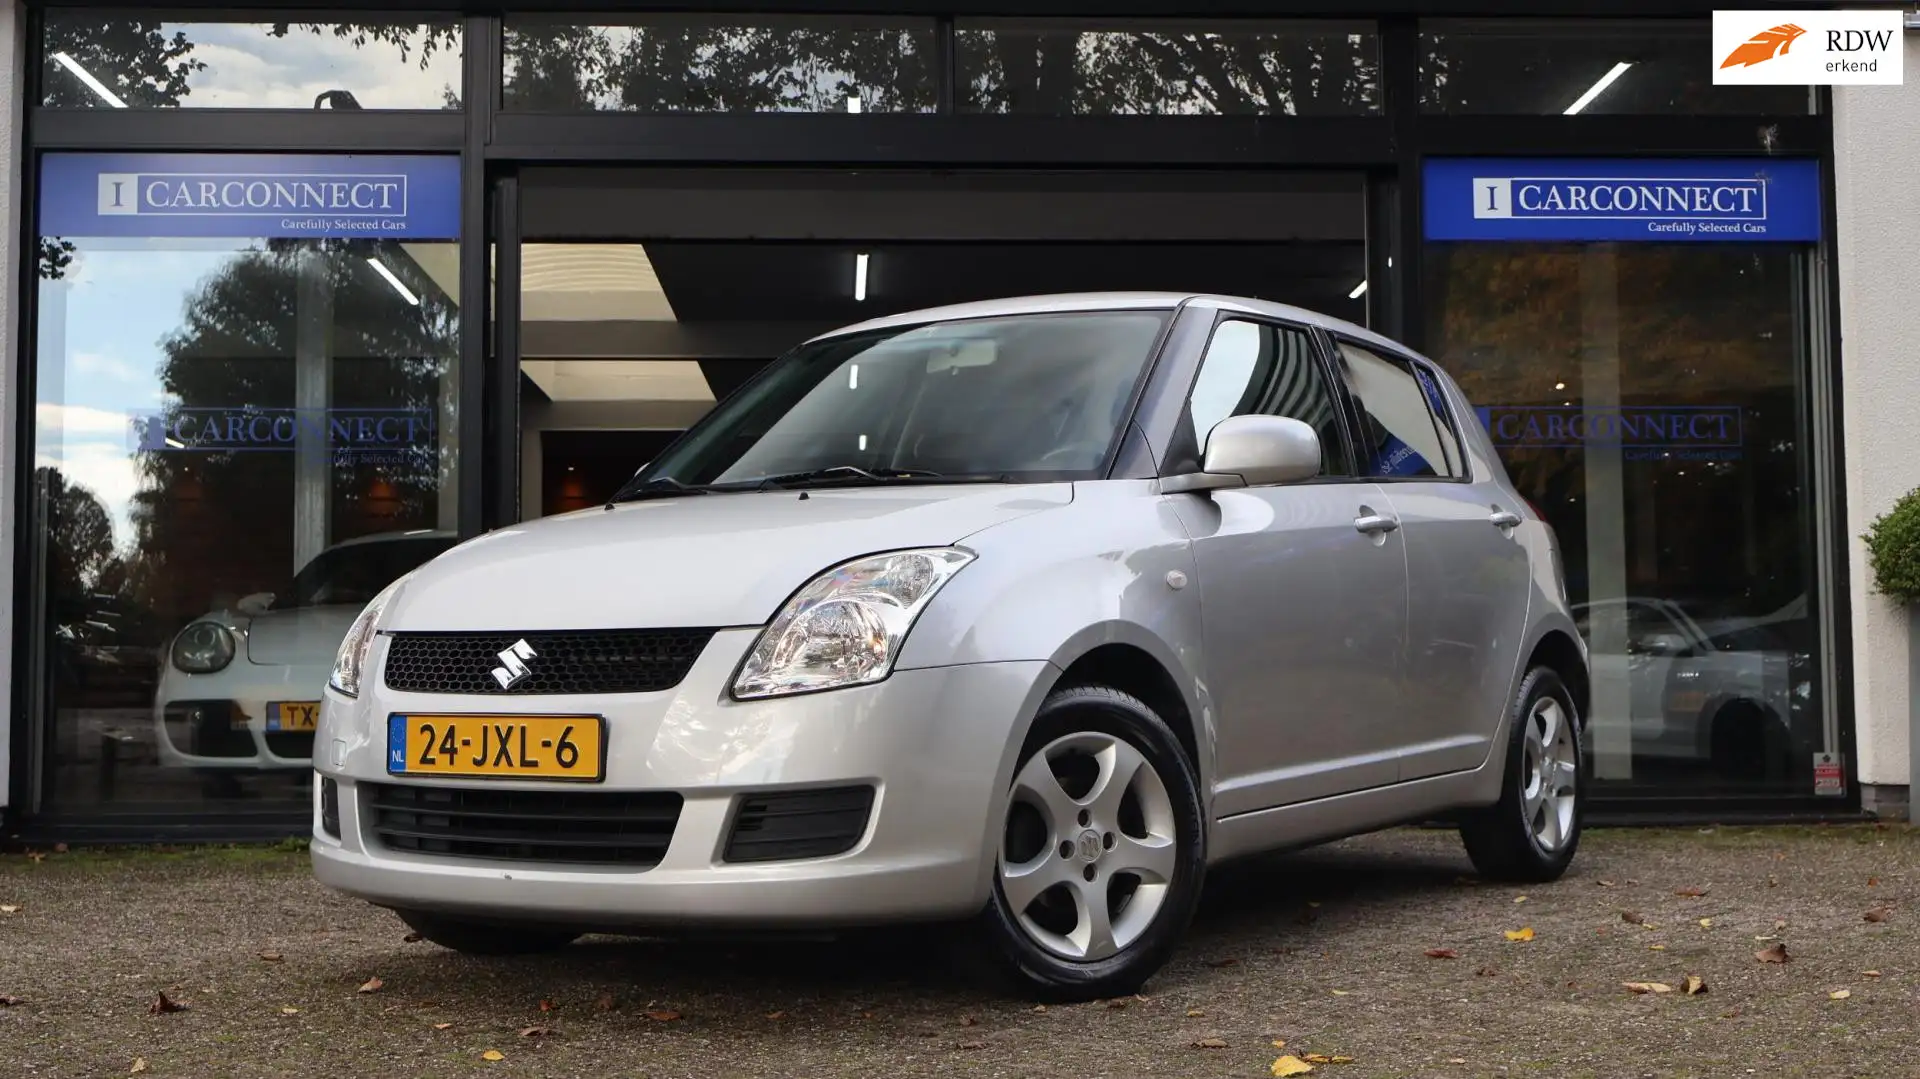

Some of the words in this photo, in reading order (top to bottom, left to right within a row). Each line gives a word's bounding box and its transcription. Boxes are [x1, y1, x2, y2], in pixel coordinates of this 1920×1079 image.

[145, 180, 398, 209] CARCONNECT
[1518, 184, 1757, 212] CARCONNECT
[281, 218, 331, 232] Carefully
[334, 219, 379, 231] Selected
[381, 220, 406, 231] Cars
[1648, 222, 1696, 235] Carefully
[1698, 222, 1741, 234] Selected
[1743, 223, 1767, 234] Cars
[1497, 413, 1734, 440] CARCONNECT
[392, 749, 405, 763] NL
[418, 723, 580, 769] 24-JXL-6
